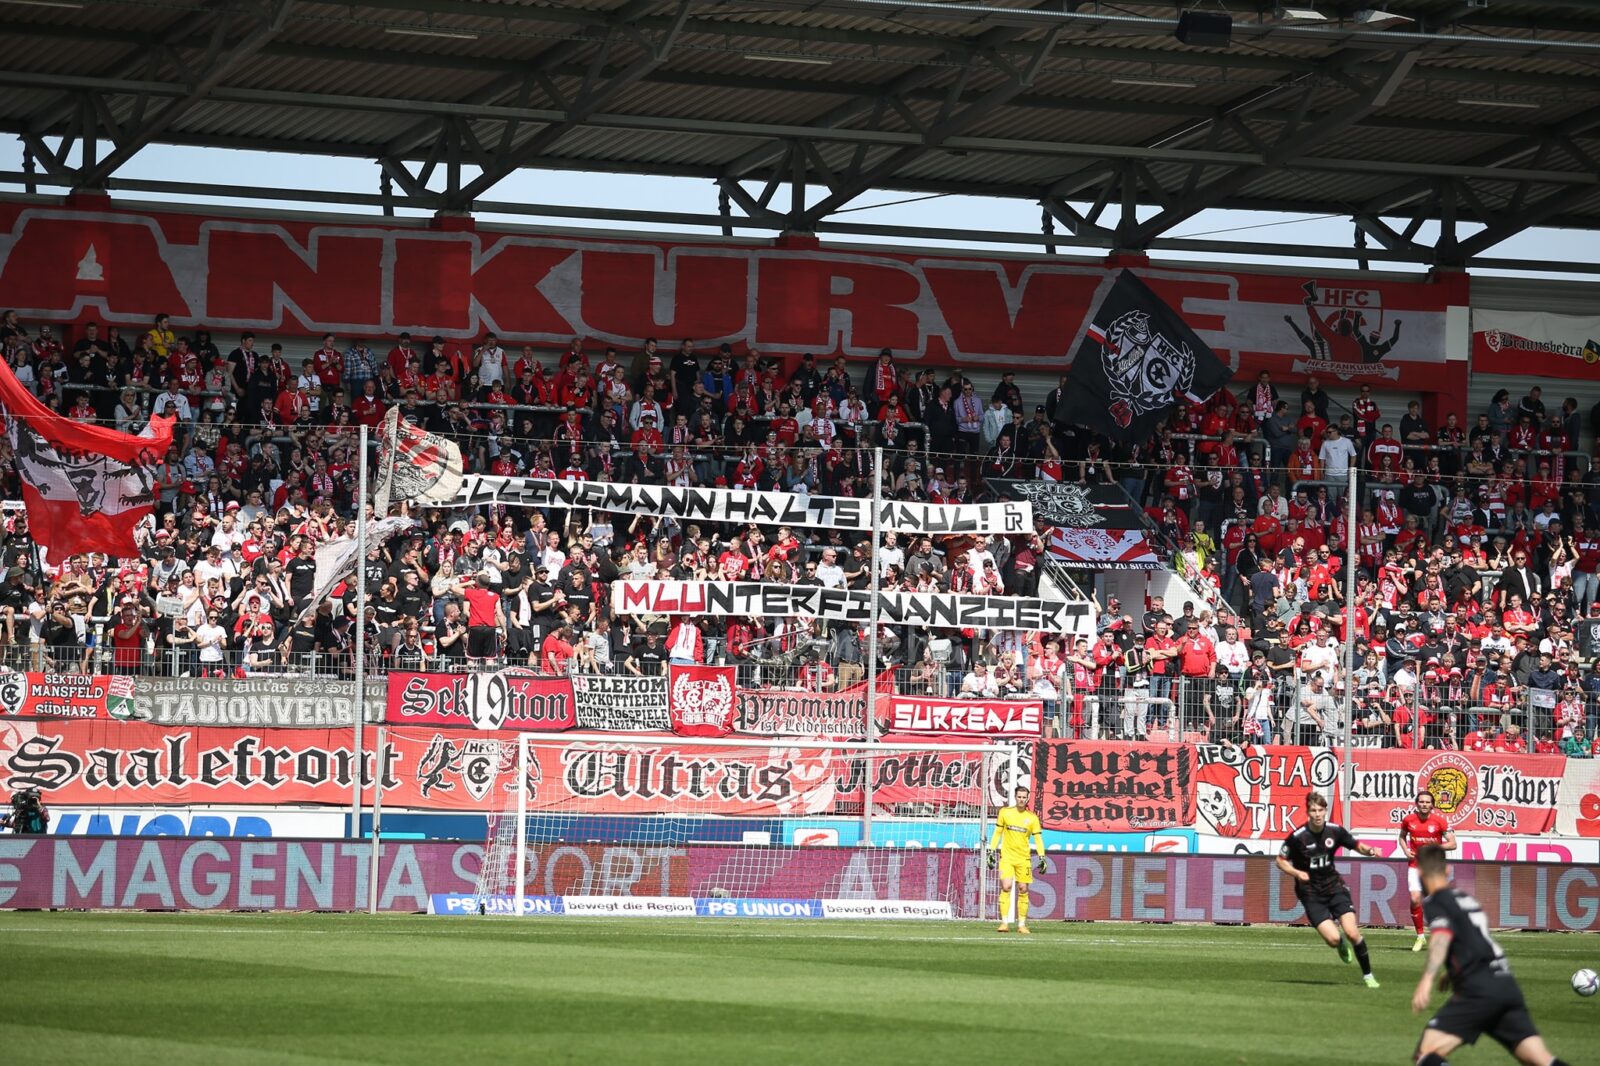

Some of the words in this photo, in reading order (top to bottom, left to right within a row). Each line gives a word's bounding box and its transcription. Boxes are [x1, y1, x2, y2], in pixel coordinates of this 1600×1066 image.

[1324, 289, 1369, 307] HFC
[1156, 340, 1181, 367] HFC
[1500, 334, 1583, 357] Braunsbedra
[432, 477, 716, 520] LLINGMANN
[725, 492, 860, 527] HALTS
[870, 502, 989, 531] MAUL!
[1046, 560, 1095, 569] EKOMMEN
[1098, 562, 1113, 570] UM
[1115, 562, 1128, 570] ZU
[1130, 562, 1162, 571] SIEGEN
[44, 673, 93, 685] SEKTION
[574, 676, 667, 694] TELEKOM
[31, 684, 104, 699] MANSFELD
[576, 691, 667, 707] BOYKOTTIEREN
[35, 701, 97, 717] SÜDHARZ
[577, 706, 668, 720] MONTAGSSPIELE
[735, 693, 867, 730] Pyromanie
[894, 704, 1040, 732] SURREALE
[579, 717, 606, 729] NICHT
[761, 720, 778, 732] ist
[785, 718, 865, 735] Leidenschaft
[469, 742, 495, 753] HFC
[7, 734, 401, 790] Saalefront
[1242, 751, 1338, 789] CHAO
[1421, 755, 1474, 778] HALLESCHER
[563, 744, 793, 800] Ultras
[1341, 764, 1416, 799] Leuna
[1244, 802, 1300, 832] TIK
[1476, 807, 1516, 828] 1984
[1309, 855, 1331, 869] ETL
[52, 839, 428, 910] MAGENTA
[1029, 855, 1245, 921] SPIELE
[1269, 860, 1399, 926] DR
[447, 898, 474, 912] PS
[568, 901, 612, 914] bewegt
[615, 901, 634, 912] die
[636, 901, 694, 915] Region
[708, 902, 738, 916] PS
[742, 902, 811, 917] UNION
[826, 904, 877, 917] bewegt
[880, 904, 899, 915] die
[902, 905, 948, 917] Region
